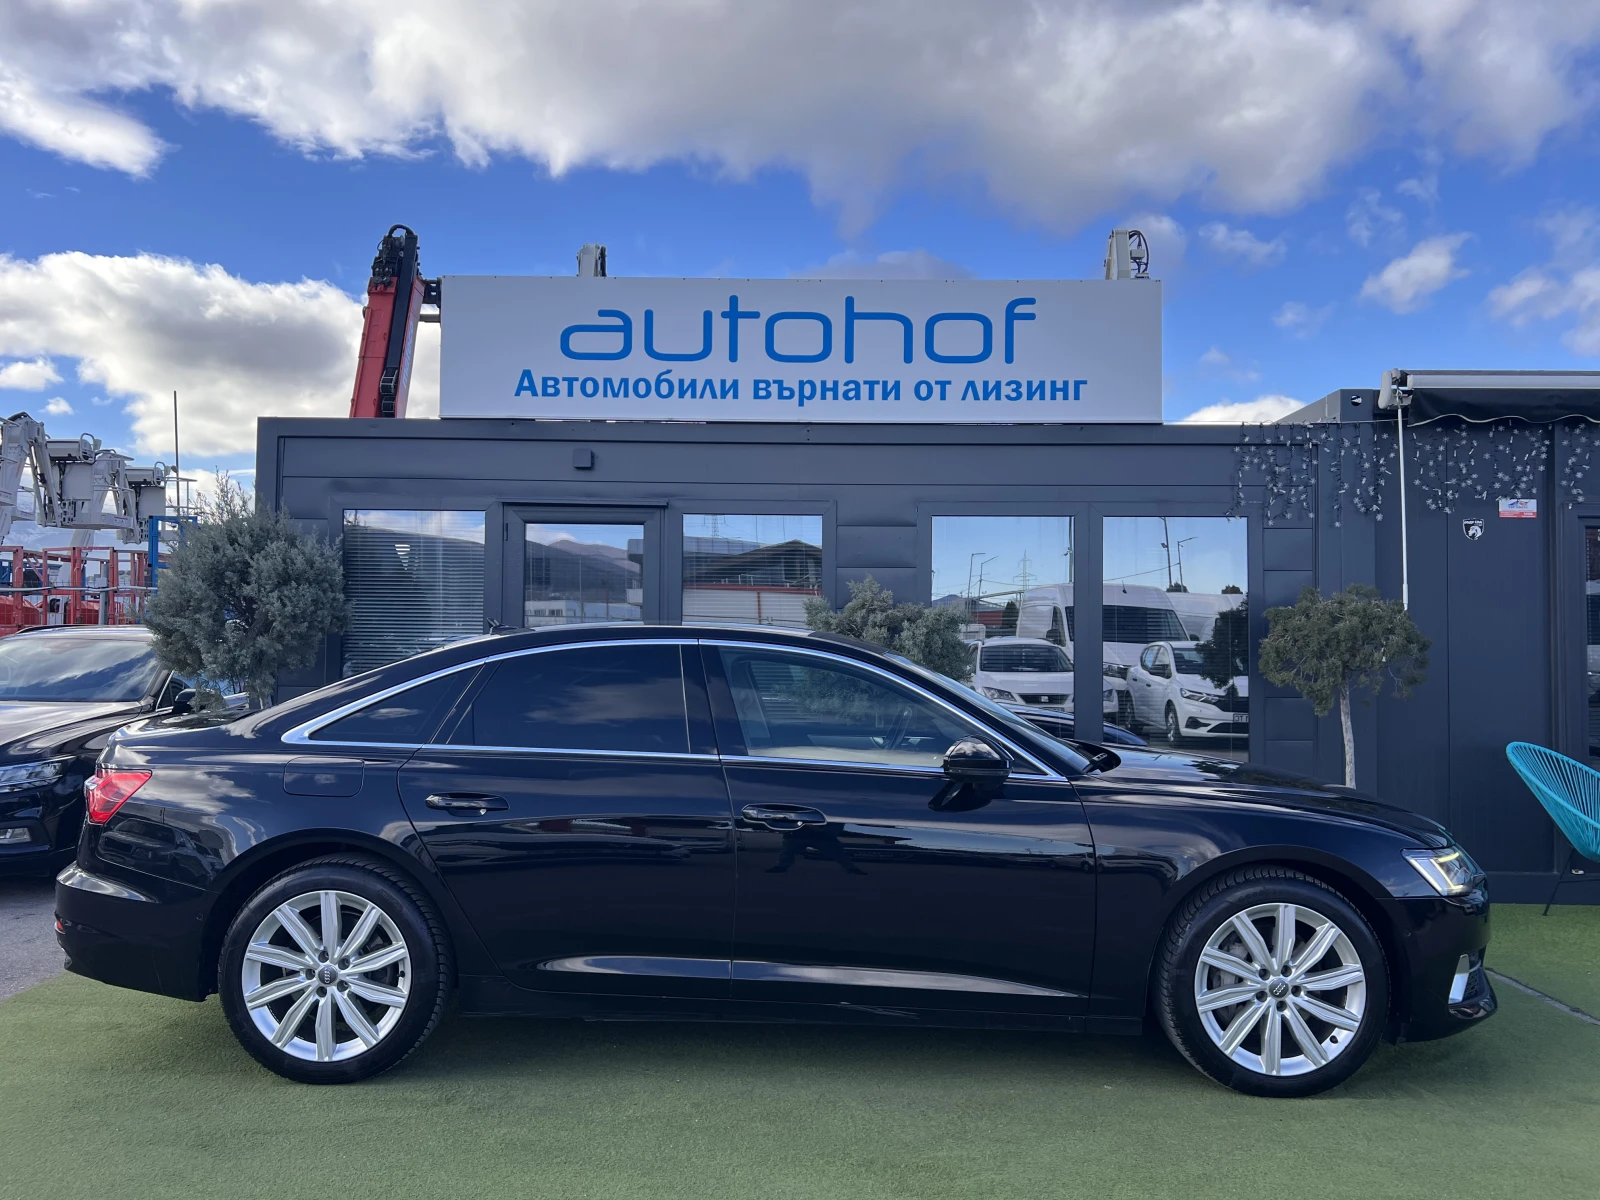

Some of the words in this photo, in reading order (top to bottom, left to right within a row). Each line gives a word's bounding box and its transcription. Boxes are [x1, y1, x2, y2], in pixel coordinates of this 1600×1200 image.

[559, 295, 1037, 365] autohof
[514, 369, 739, 400] Автомобили
[753, 379, 901, 407] върнати
[913, 379, 952, 402] от
[961, 379, 1088, 402] лизинг
